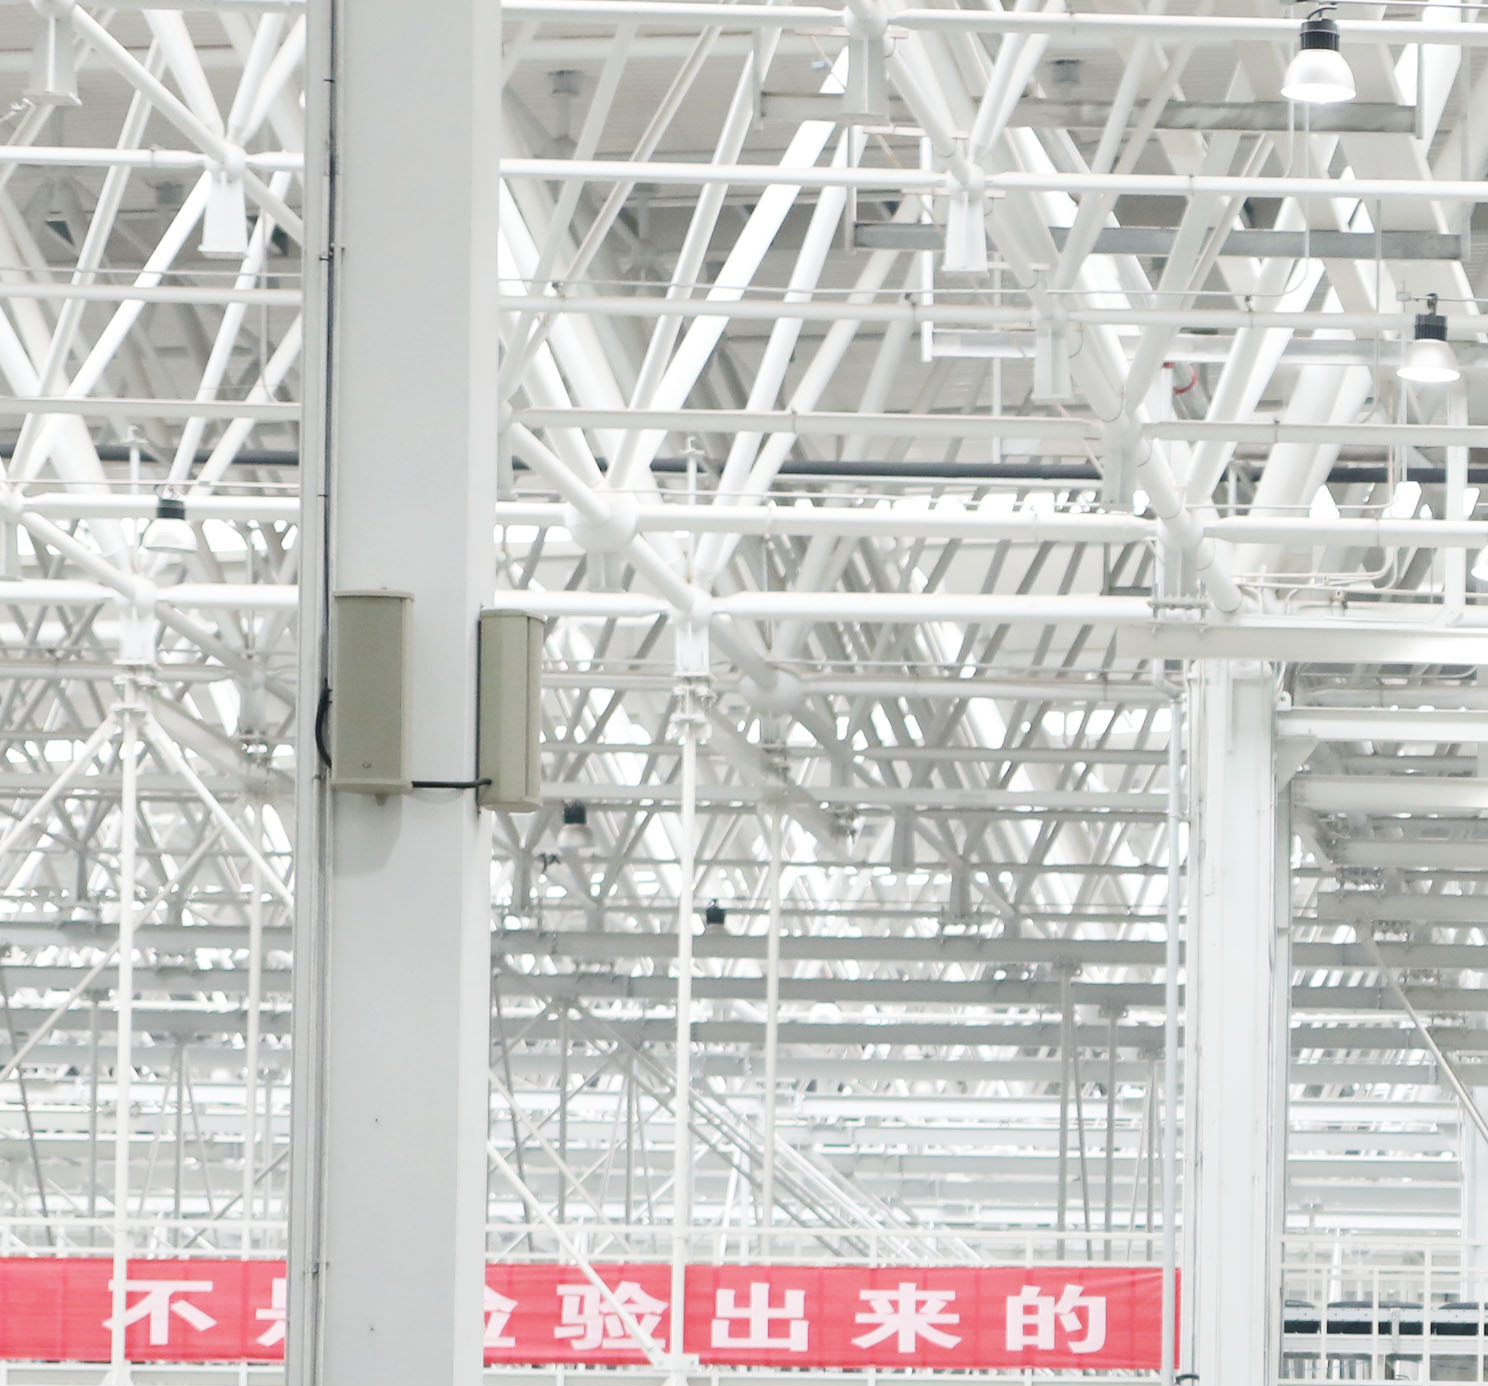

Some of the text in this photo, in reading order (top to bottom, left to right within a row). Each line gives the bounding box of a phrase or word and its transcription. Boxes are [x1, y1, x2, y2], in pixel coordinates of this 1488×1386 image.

[103, 1278, 1108, 1354] 不验出来的
